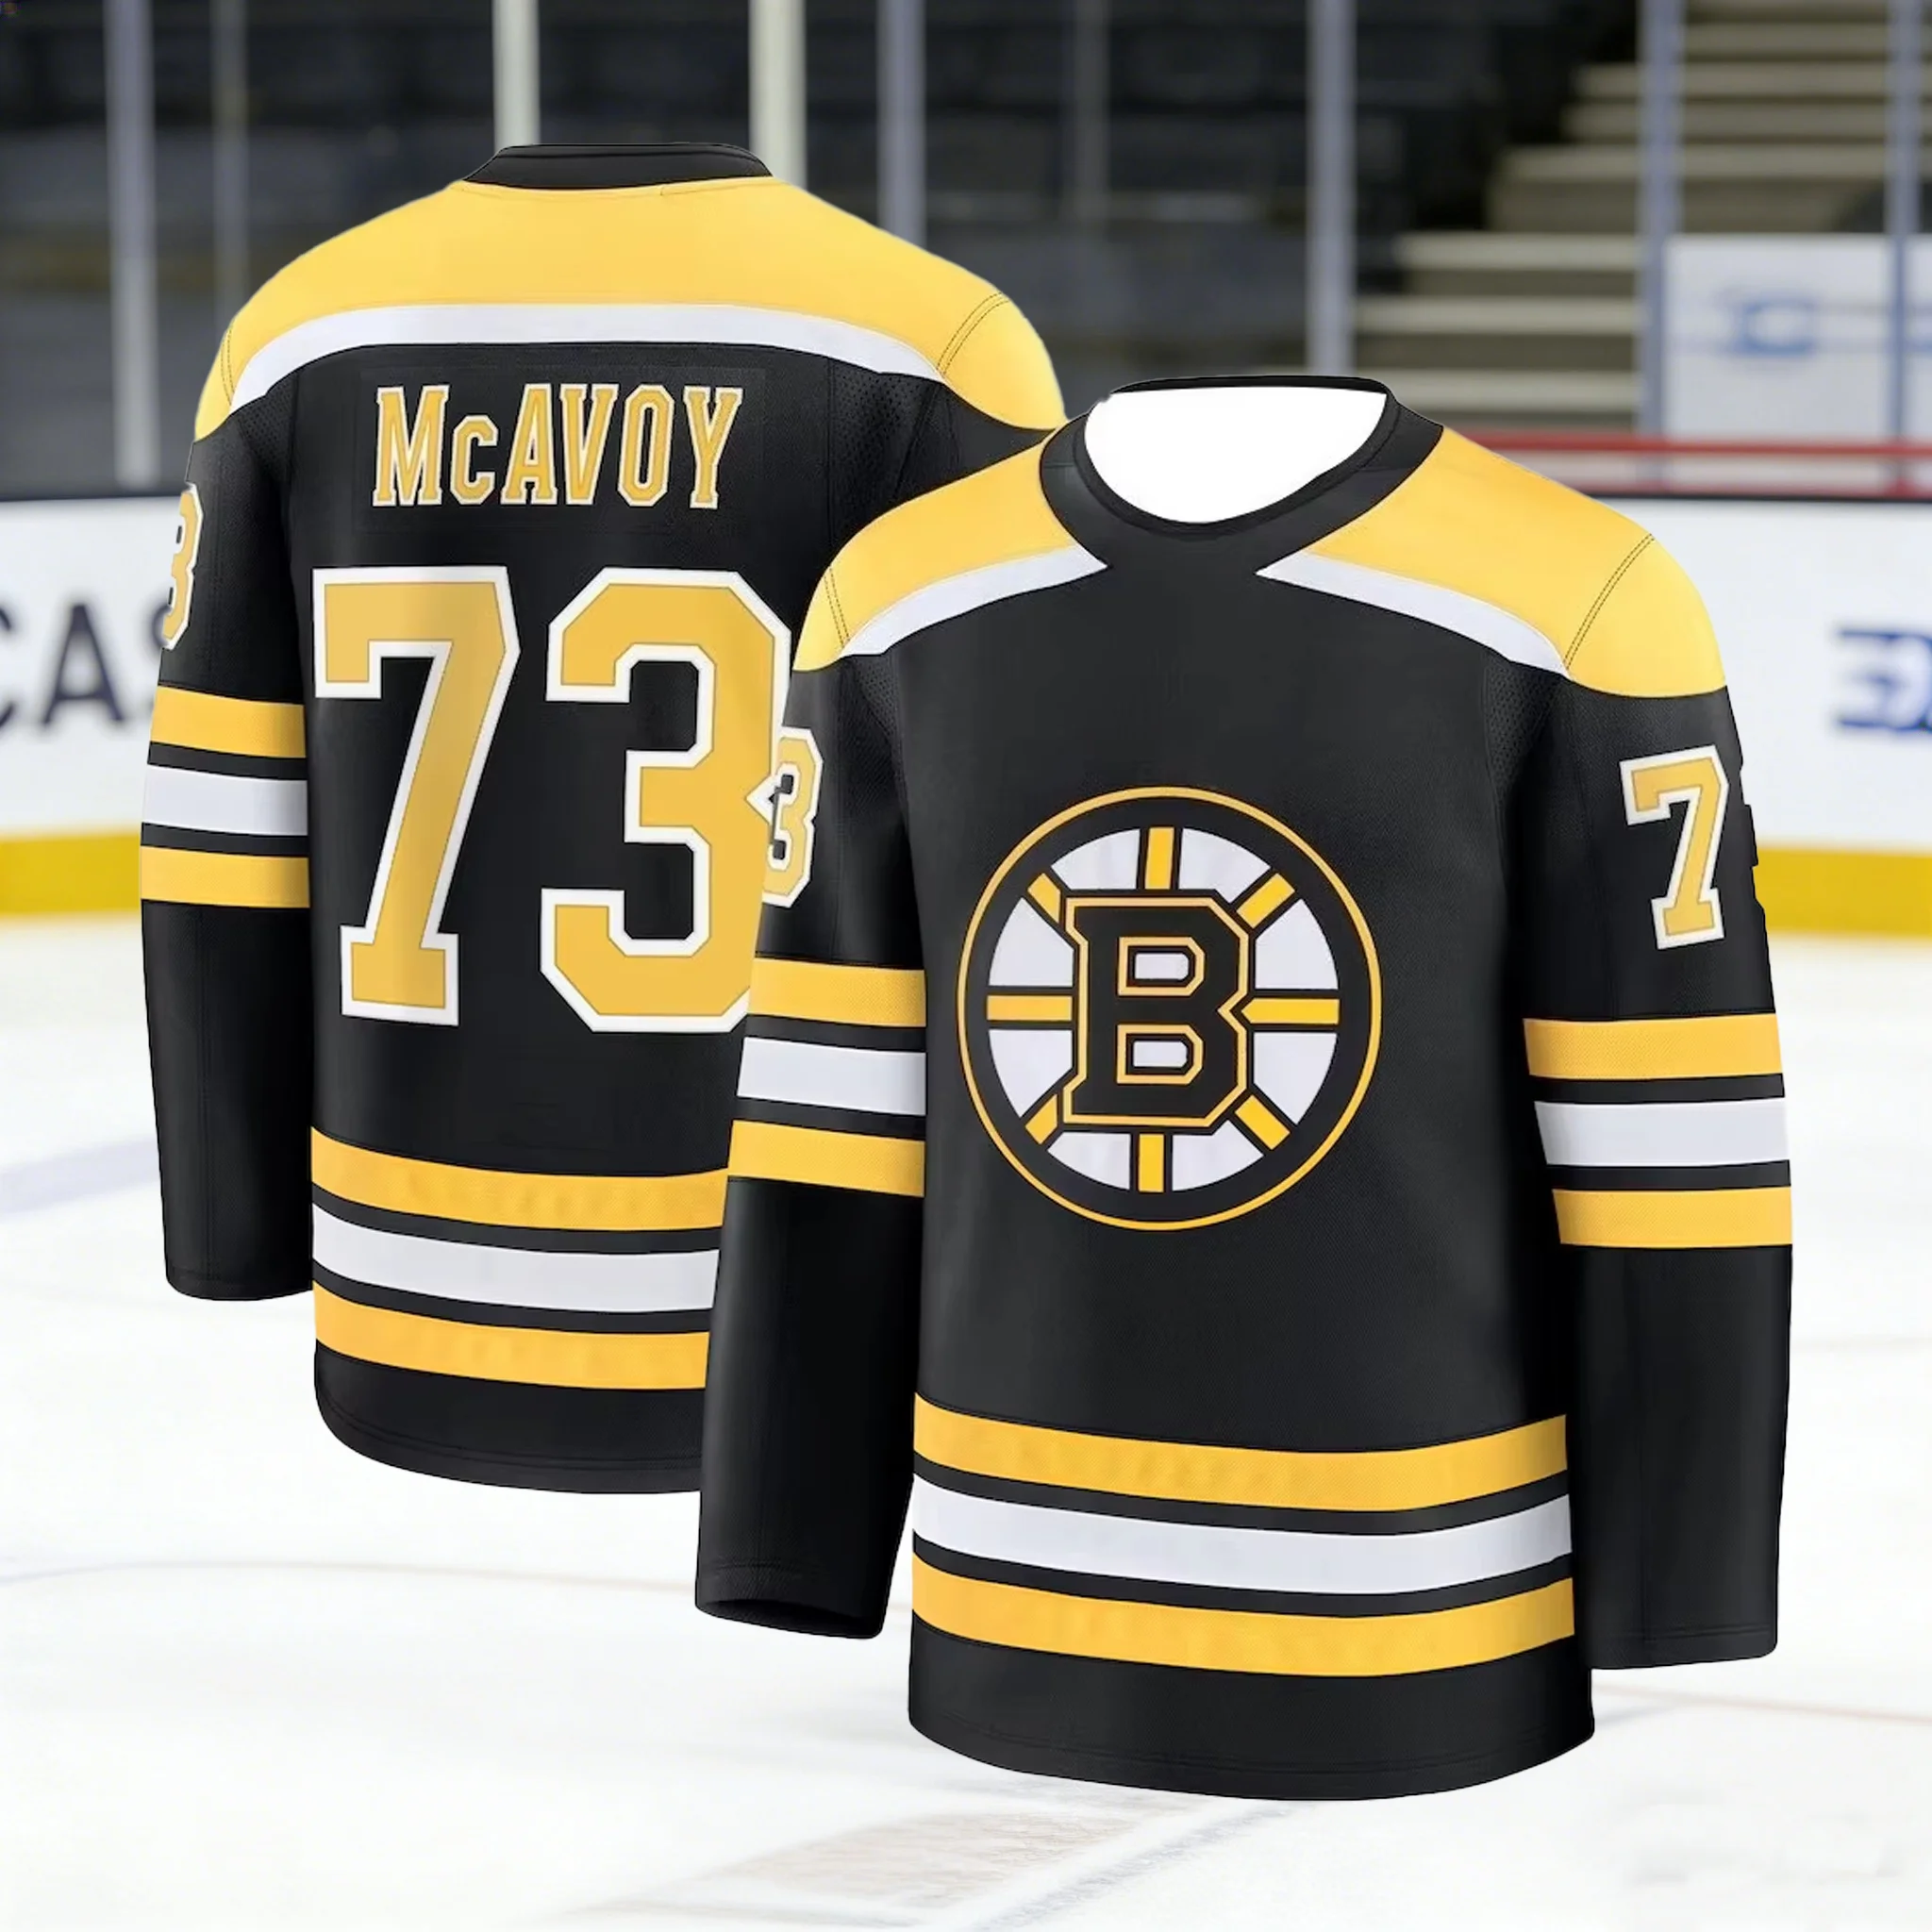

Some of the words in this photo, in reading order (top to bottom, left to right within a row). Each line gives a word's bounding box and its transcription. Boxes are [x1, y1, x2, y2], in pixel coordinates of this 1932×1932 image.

[373, 383, 743, 509] McAVOY
[312, 566, 791, 1033] 73
[1620, 744, 1729, 950] 7
[1063, 896, 1249, 1127] B
